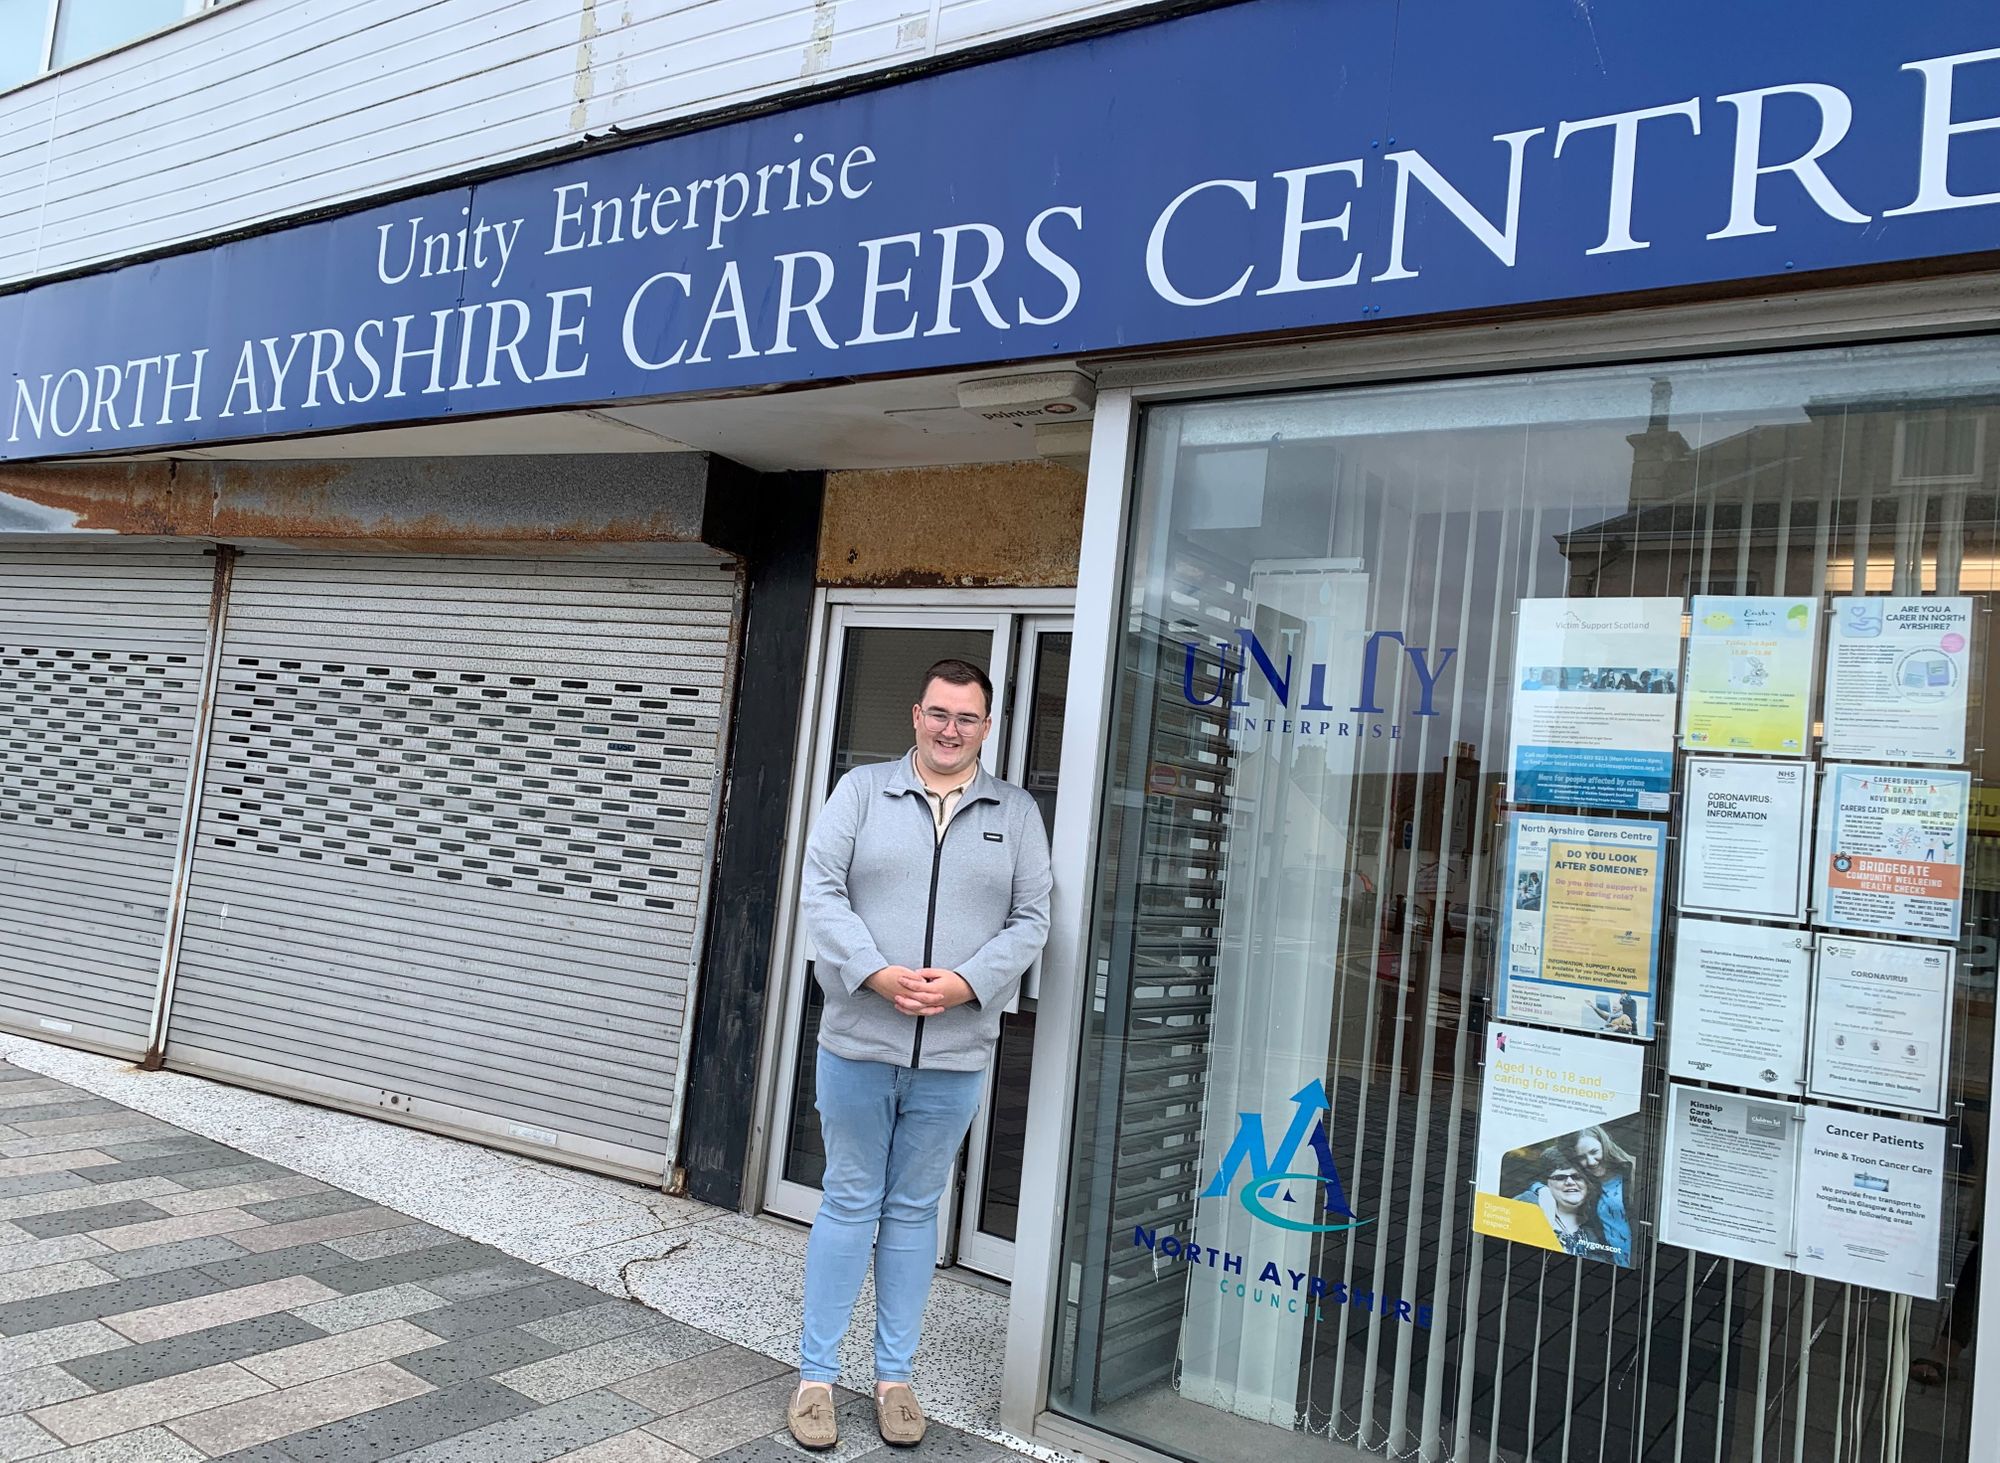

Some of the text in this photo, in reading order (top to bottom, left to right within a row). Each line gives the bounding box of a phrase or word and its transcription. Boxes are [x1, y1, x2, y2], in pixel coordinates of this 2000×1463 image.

[377, 132, 877, 288] Unity Enterprise
[8, 48, 2000, 442] NORTH AYRSHIRE CARERS CENTRE
[981, 408, 1044, 420] pointer
[1744, 609, 1776, 617] Easter
[1581, 622, 1612, 630] Support
[1229, 716, 1402, 739] ENTERPRISE
[1565, 776, 1586, 784] people
[1588, 777, 1615, 786] affected
[1617, 778, 1624, 786] by
[1708, 793, 1772, 803] CORONAVIRUS:
[1708, 801, 1737, 809] PUBLIC
[1870, 796, 1907, 804] NOVEMBER
[1707, 810, 1767, 820] INFORMATION
[1841, 805, 1866, 813] CARERS
[1868, 806, 1889, 814] CATCH
[1917, 810, 1941, 818] ONLINE
[1521, 824, 1652, 841] North Ayrshire Carers Centre
[1567, 850, 1637, 863] DO YOU LOOK
[1555, 861, 1648, 876] AFTER SOMEONE?
[1859, 861, 1930, 877] BRIDGEGATE
[1568, 880, 1581, 888] you
[1584, 880, 1603, 888] need
[1606, 883, 1637, 892] support
[1846, 872, 1942, 887] COMMUNITY WELLBEING
[1586, 890, 1611, 900] caring
[1613, 892, 1634, 900] role?
[1861, 881, 1925, 895] HEALTH CHECKS
[1512, 943, 1539, 955] UNITY
[1851, 970, 1908, 983] CORONAVIRUS
[1495, 1060, 1601, 1087] Aged 16 to 18 and
[1494, 1072, 1616, 1101] caring for someone?
[1829, 1073, 1847, 1081] Please
[1897, 1083, 1921, 1093] building
[1690, 1108, 1710, 1117] Care
[1691, 1101, 1722, 1112] Kinship
[1689, 1115, 1712, 1125] Week
[1826, 1125, 1924, 1150] Cancer Patients
[1814, 1148, 1933, 1175] Irvine & Troon Cancer Care
[1834, 1187, 1861, 1198] provide
[1863, 1192, 1877, 1201] free
[1878, 1195, 1912, 1209] transport
[1913, 1201, 1921, 1209] to
[1816, 1193, 1846, 1205] hospitals
[1857, 1201, 1886, 1212] Glasgow
[1896, 1207, 1925, 1219] Ayrshire
[1828, 1204, 1912, 1226] from the following areas
[1578, 1238, 1621, 1254] mygov.scot
[1134, 1225, 1433, 1329] NORTH AYRSHIRE
[1220, 1280, 1323, 1322] COUNCIL
